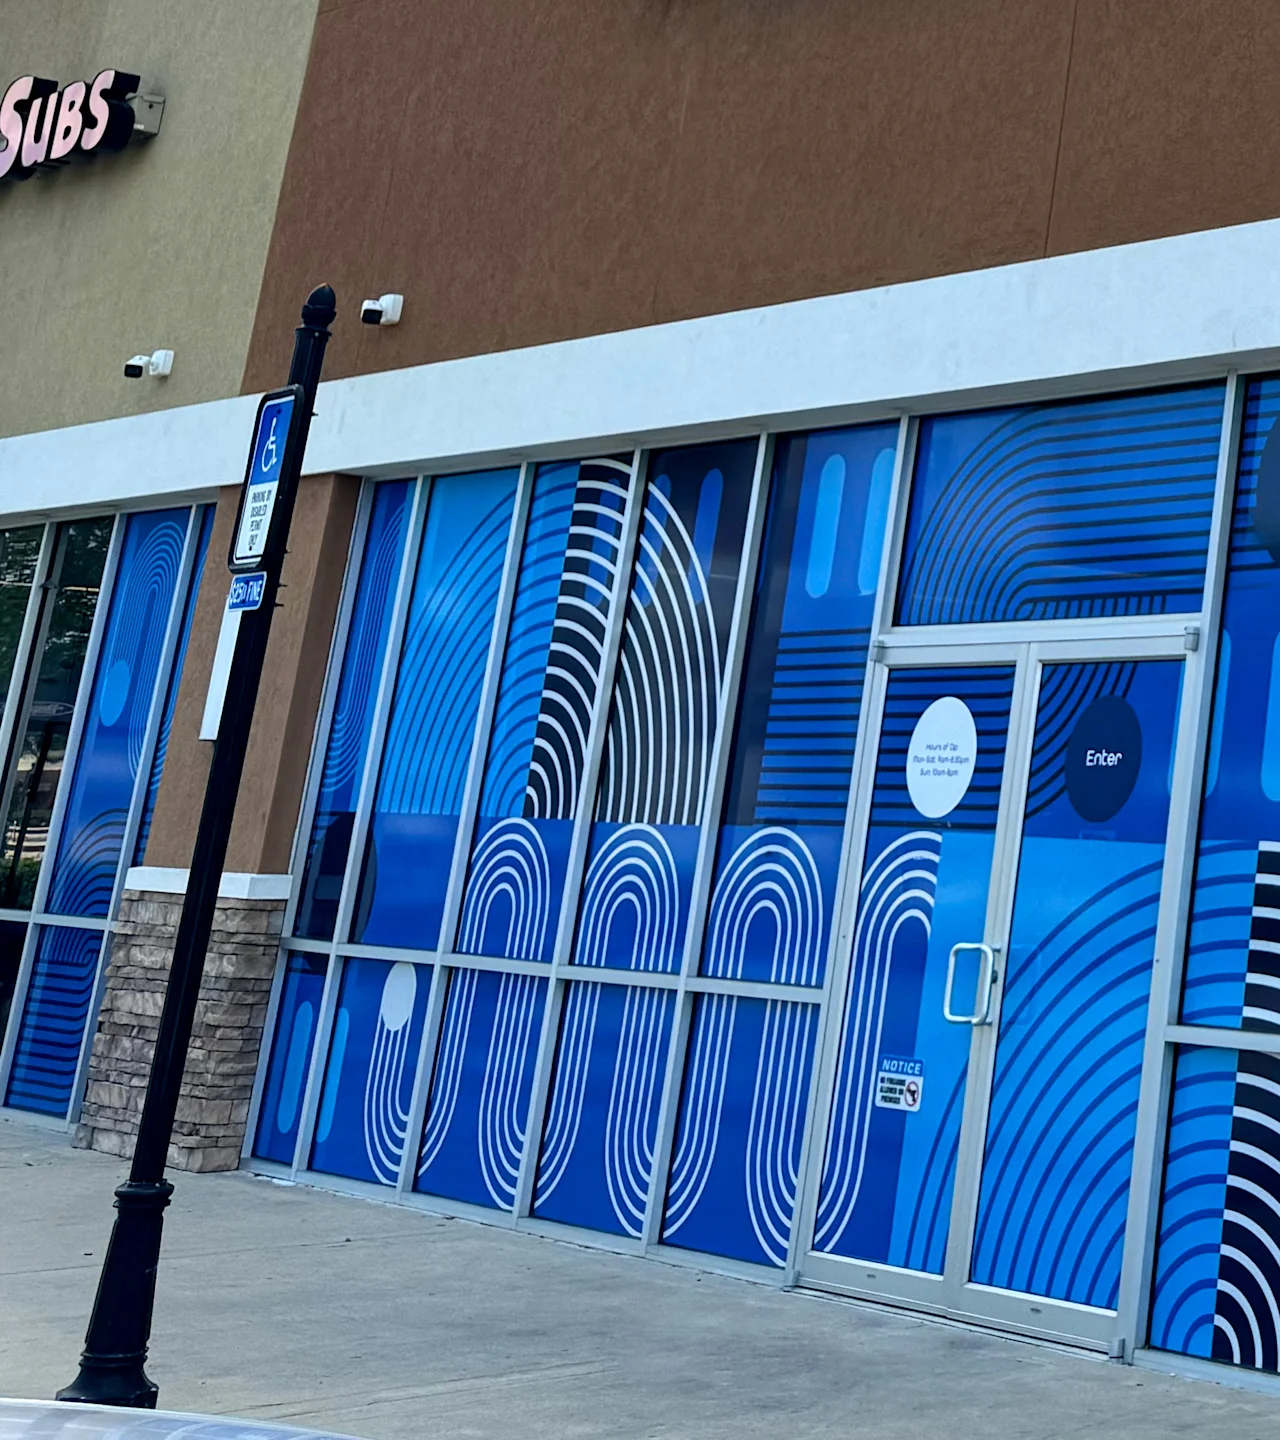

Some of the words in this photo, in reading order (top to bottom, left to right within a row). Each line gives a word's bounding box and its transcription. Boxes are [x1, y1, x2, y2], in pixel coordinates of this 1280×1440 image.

[0, 68, 117, 179] SUBS
[1085, 748, 1123, 766] Enter
[882, 1059, 922, 1075] NOTICE
